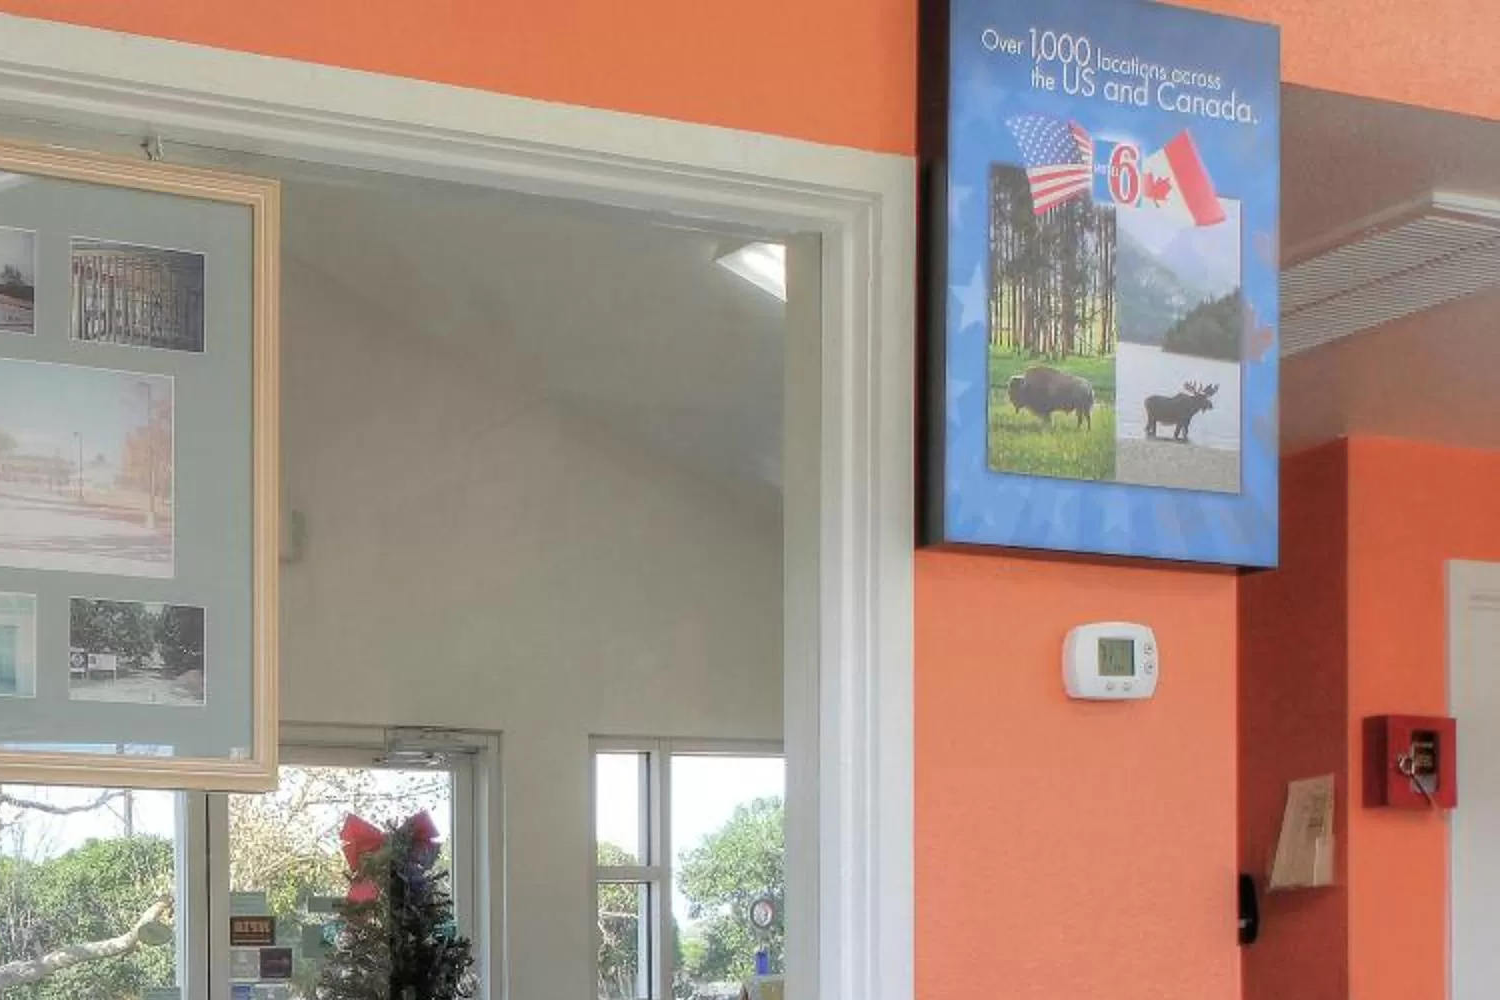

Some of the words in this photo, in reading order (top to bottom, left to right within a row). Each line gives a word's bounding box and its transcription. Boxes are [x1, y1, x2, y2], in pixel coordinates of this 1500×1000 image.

[981, 28, 1023, 55] Over
[1029, 27, 1091, 67] 1,000
[1097, 48, 1166, 81] locations
[1171, 67, 1221, 91] across
[1031, 65, 1056, 90] the
[1063, 62, 1095, 97] US
[1103, 75, 1149, 106] and
[1157, 81, 1259, 125] Canada.
[1108, 143, 1141, 206] 6
